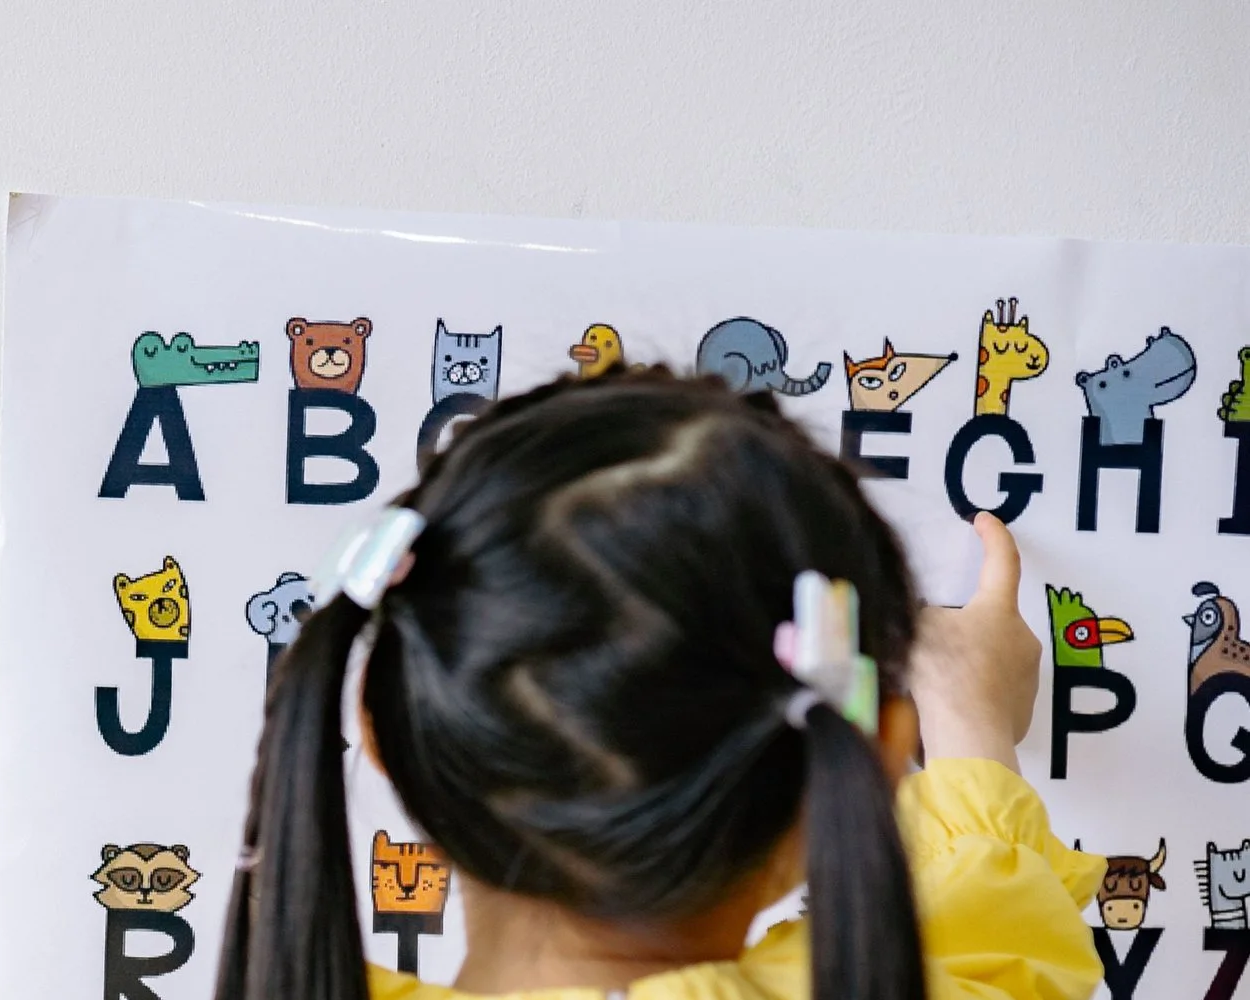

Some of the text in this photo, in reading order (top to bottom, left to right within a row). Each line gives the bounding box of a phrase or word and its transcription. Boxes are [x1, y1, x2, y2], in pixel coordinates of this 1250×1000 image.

[97, 386, 206, 501] A
[285, 388, 380, 504] B
[944, 413, 1044, 525] G
[1075, 415, 1165, 534] H
[94, 639, 189, 756] J
[1050, 665, 1137, 780] P
